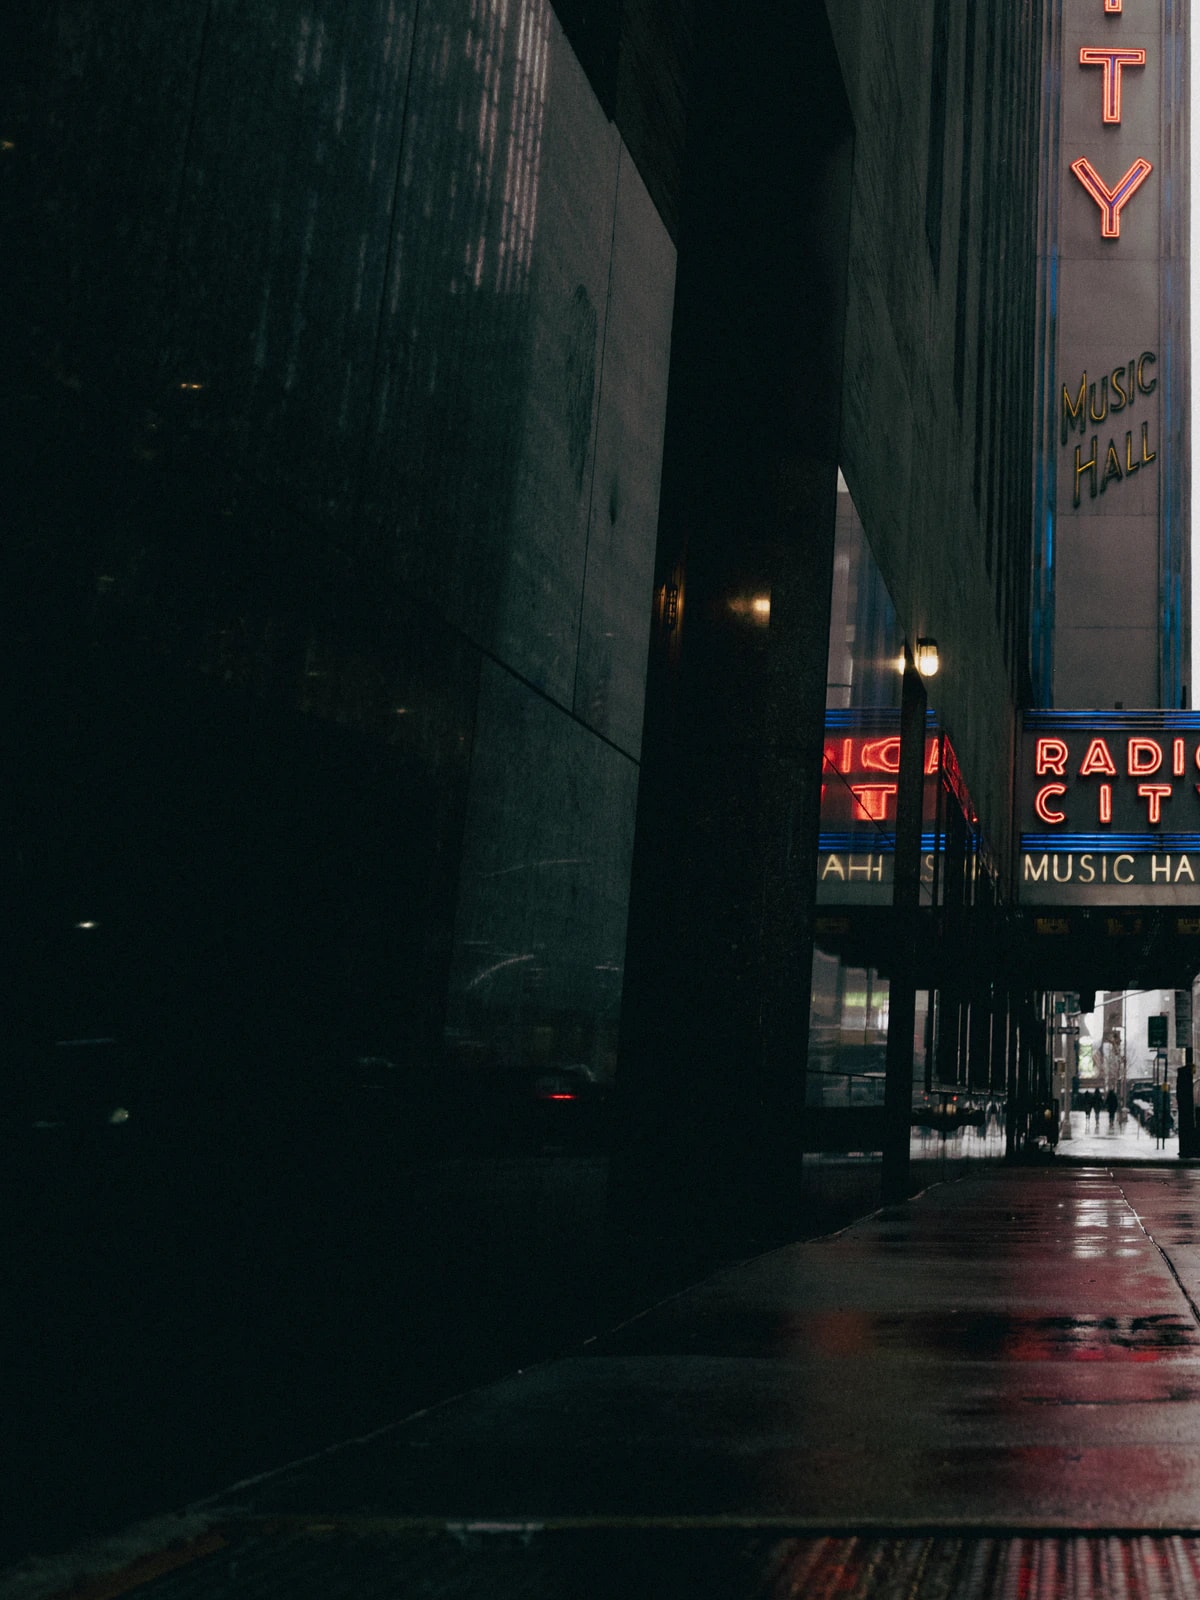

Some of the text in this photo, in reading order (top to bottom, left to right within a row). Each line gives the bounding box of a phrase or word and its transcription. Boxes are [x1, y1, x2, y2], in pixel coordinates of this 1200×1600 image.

[1061, 350, 1158, 446] MUSIC
[1073, 420, 1157, 509] HALL
[1024, 854, 1136, 884] MUSIC
